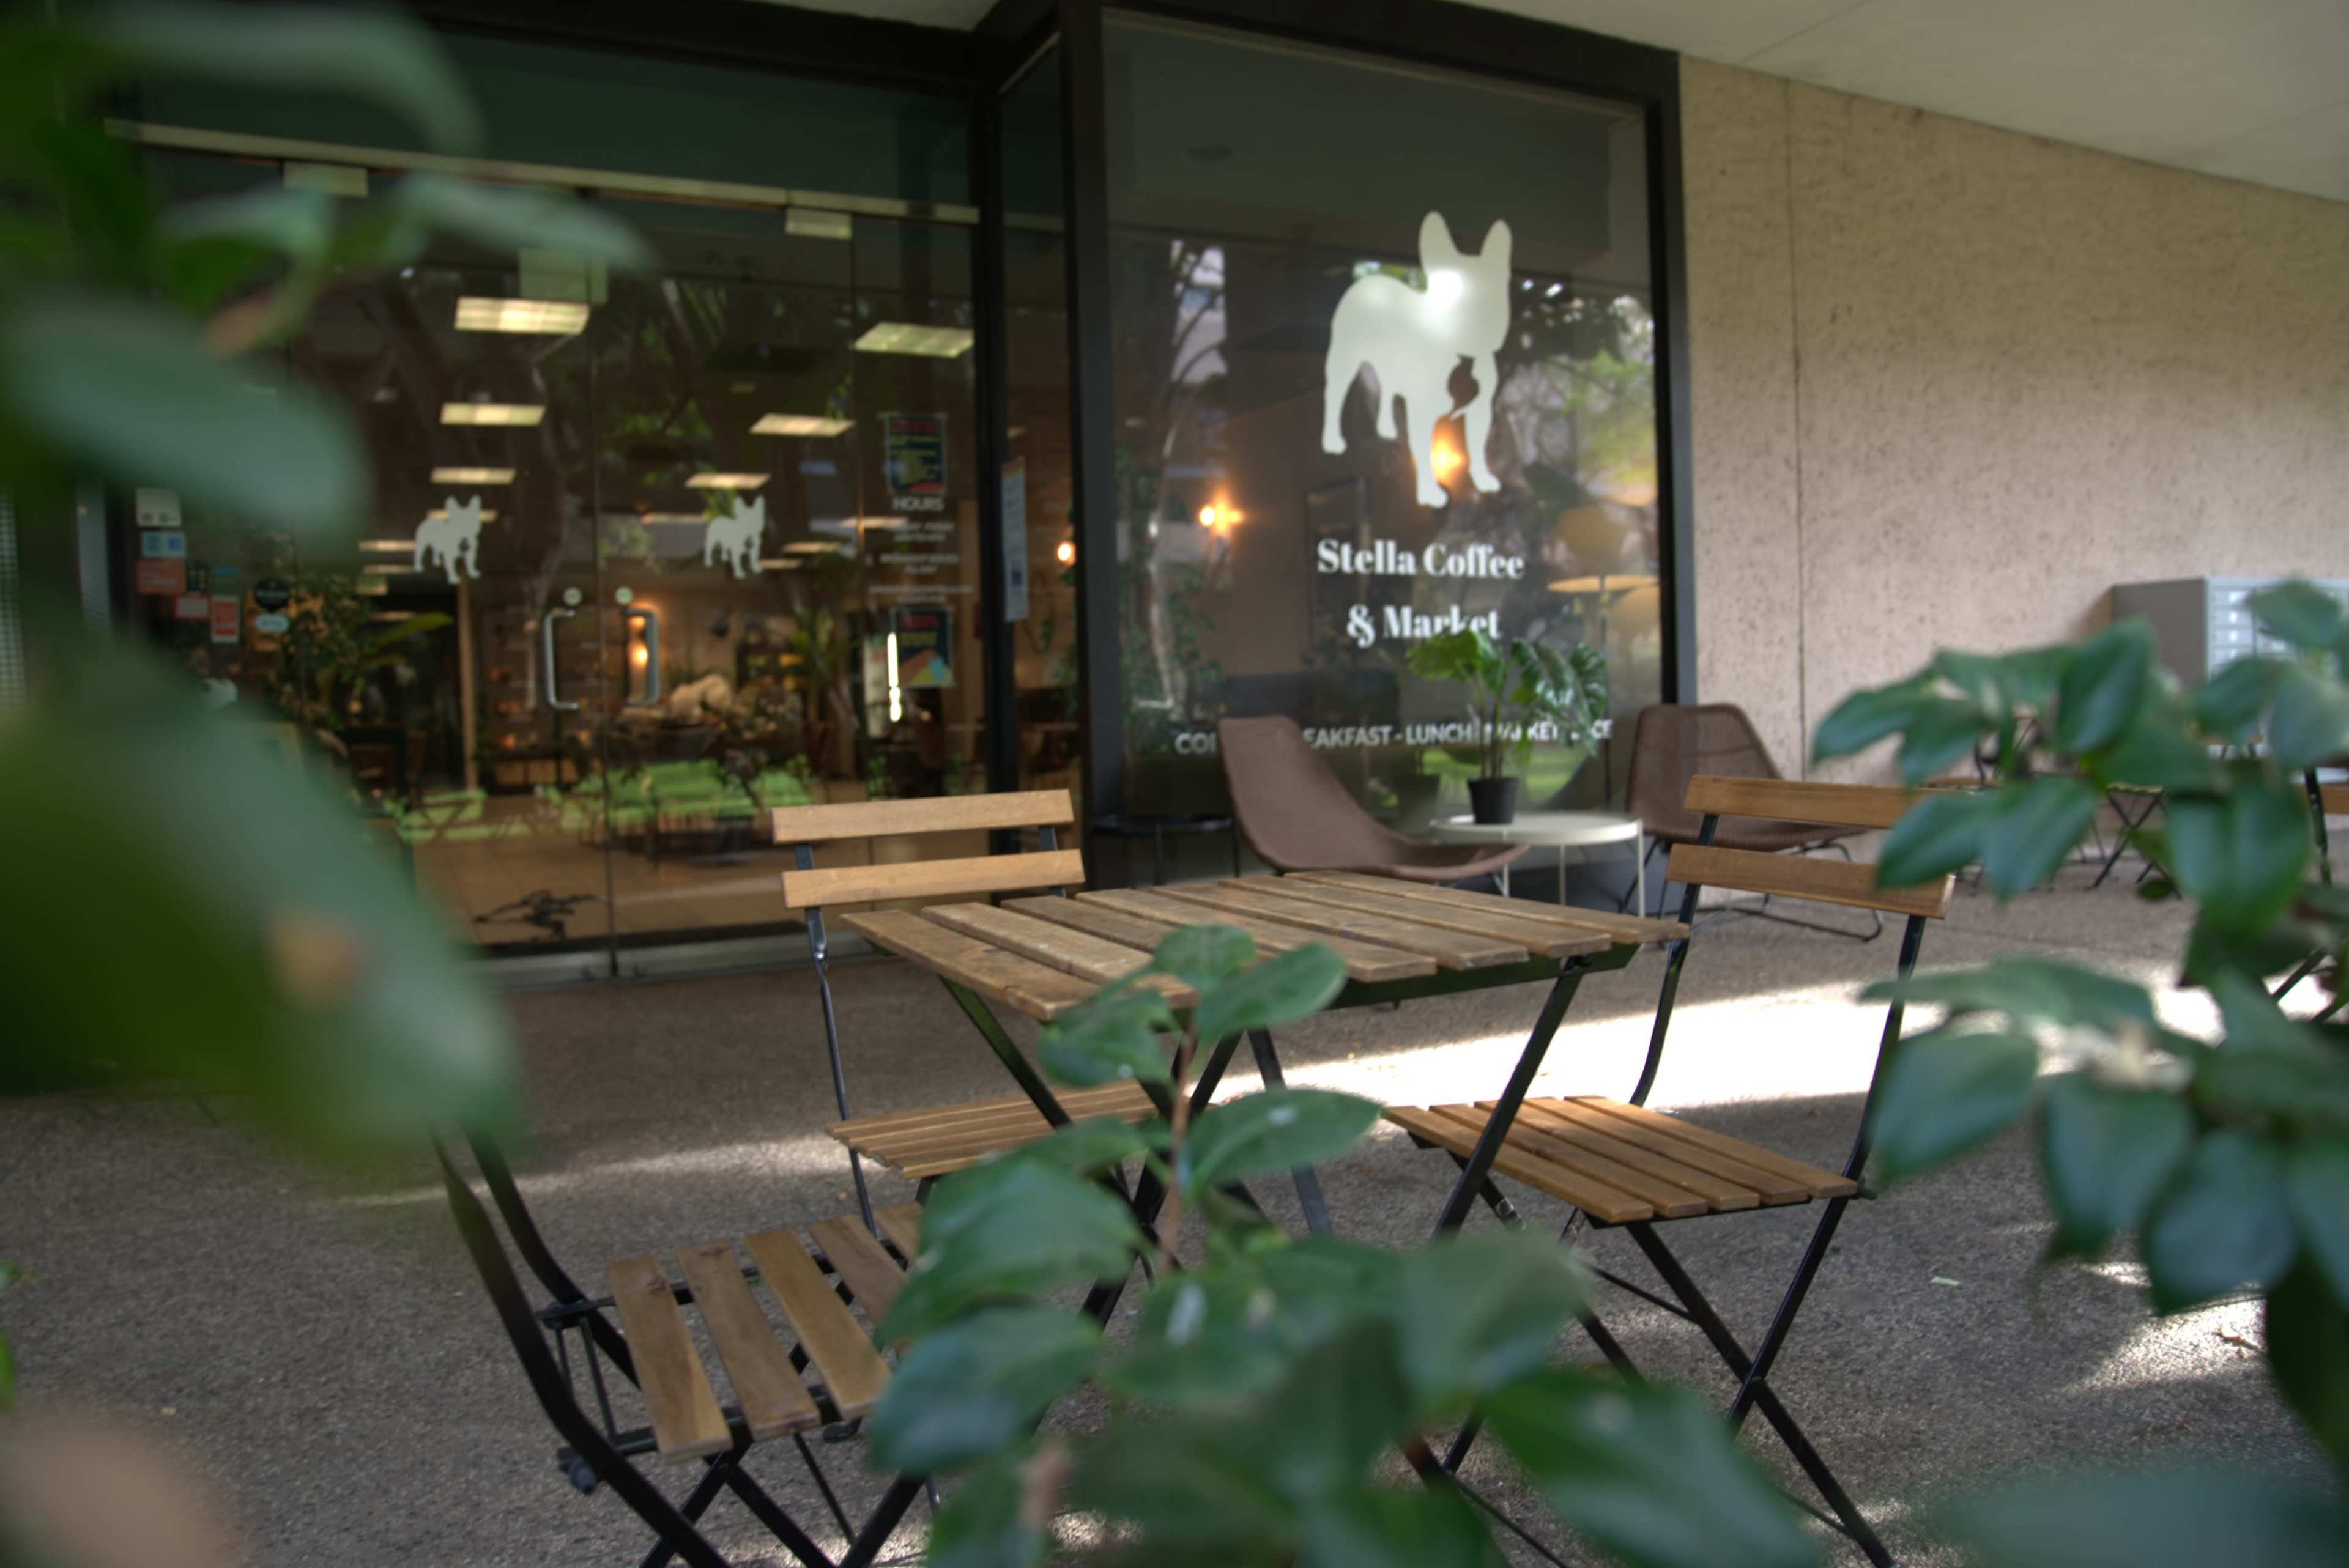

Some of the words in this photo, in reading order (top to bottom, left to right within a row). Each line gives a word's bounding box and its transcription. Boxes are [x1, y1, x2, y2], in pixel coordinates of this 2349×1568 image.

[1317, 539, 1417, 575] Stella
[1423, 542, 1525, 579] Coffee
[1346, 604, 1376, 648] &
[1384, 605, 1503, 640] Market
[1406, 723, 1473, 744] LUNCH
